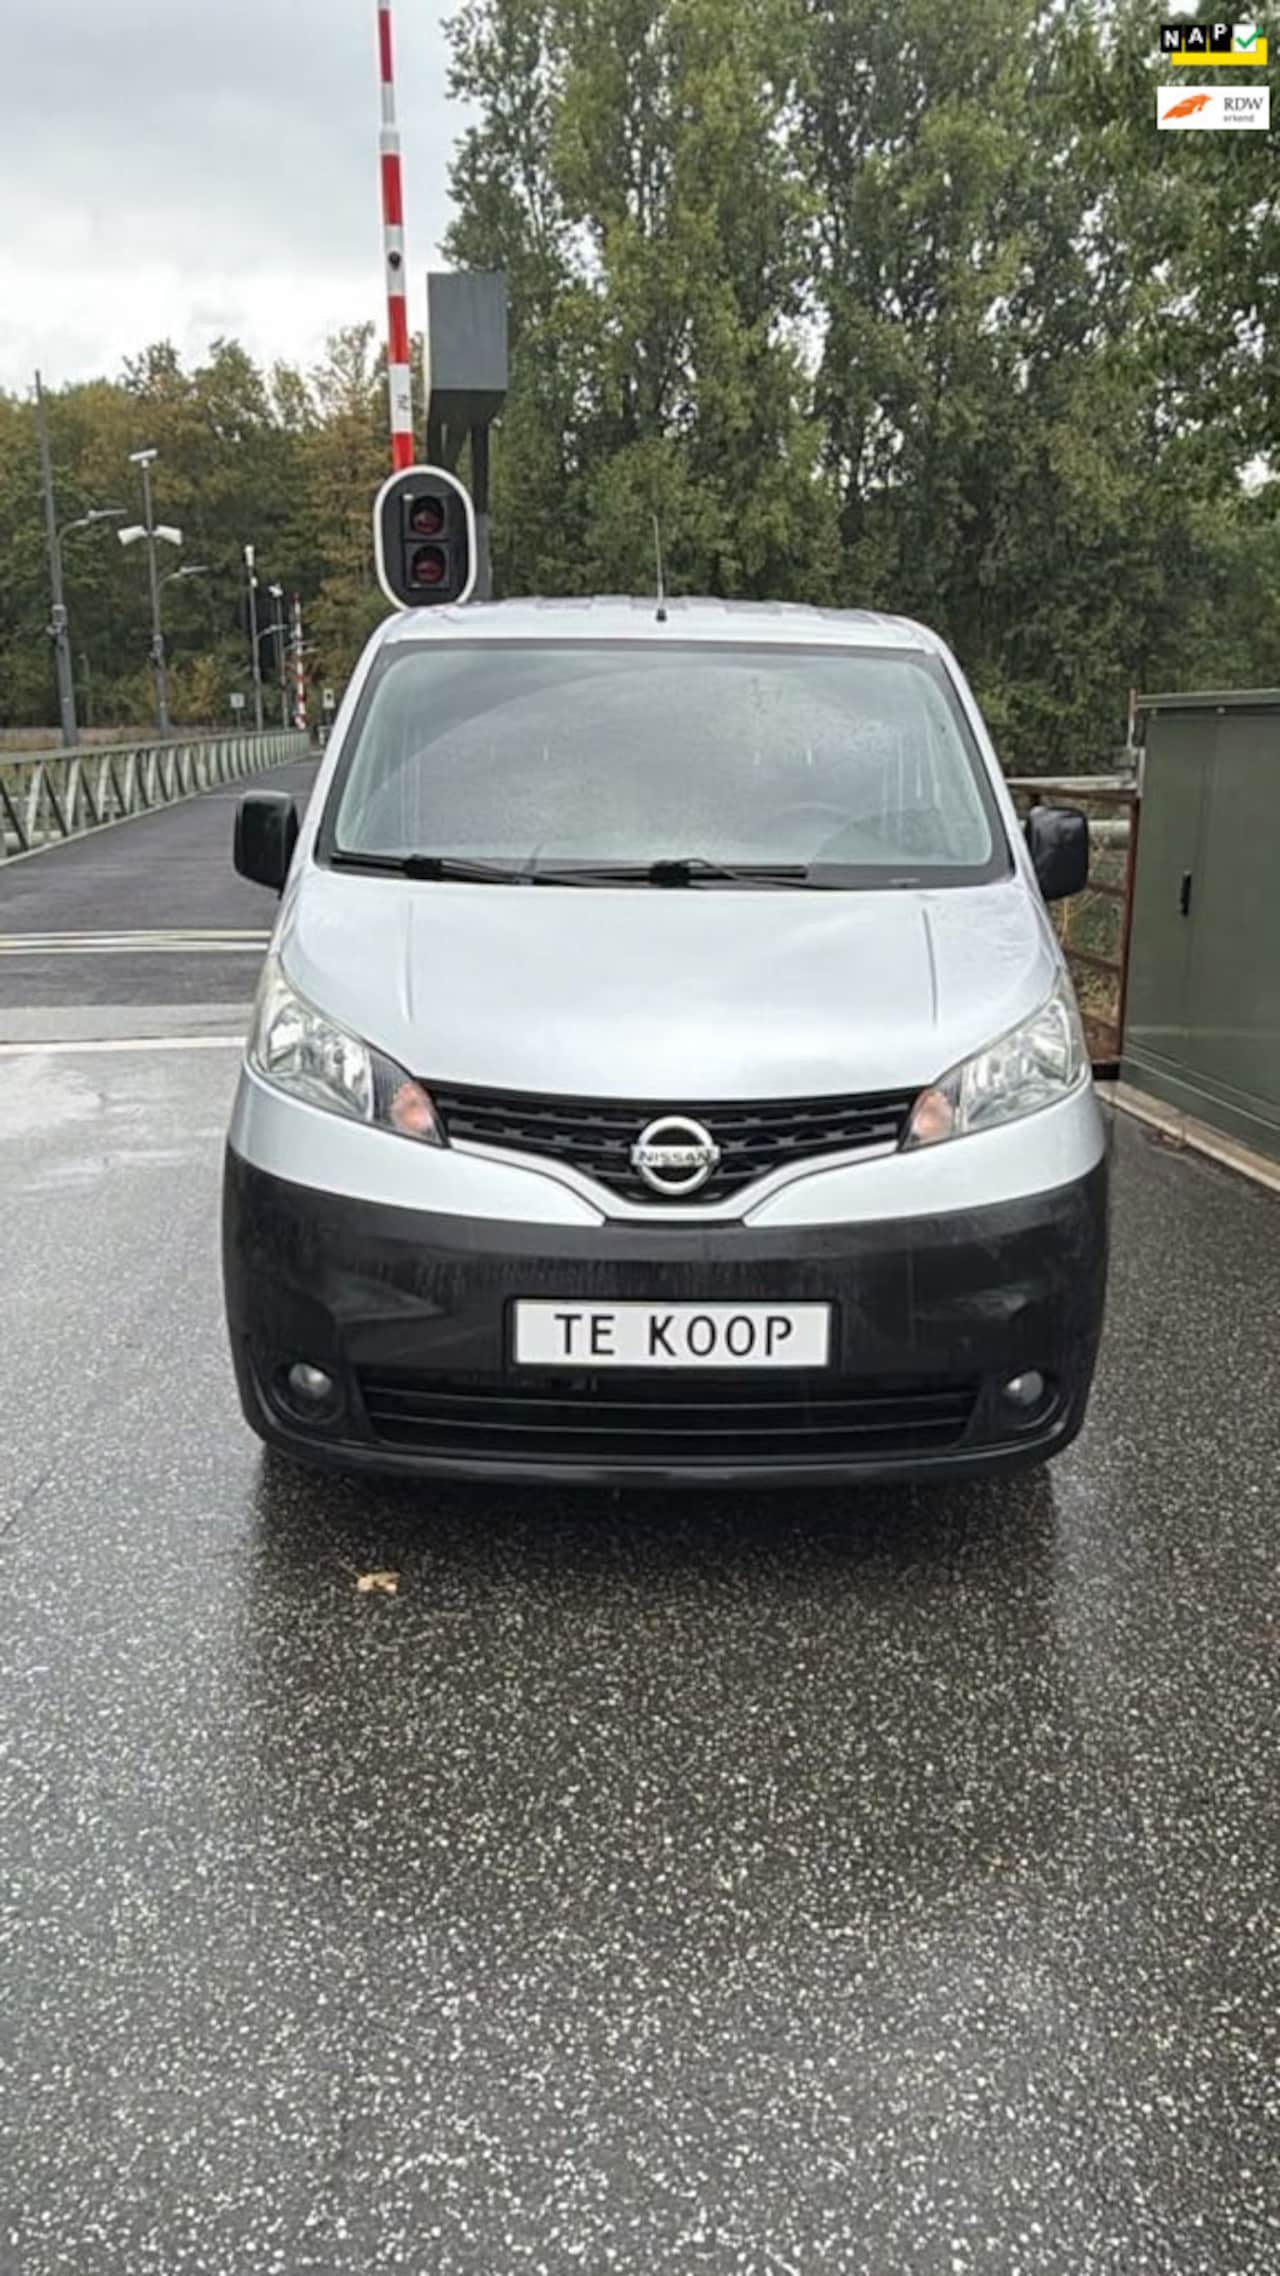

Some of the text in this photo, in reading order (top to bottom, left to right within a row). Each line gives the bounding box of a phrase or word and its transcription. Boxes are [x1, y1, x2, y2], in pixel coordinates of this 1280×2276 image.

[637, 1148, 714, 1164] NISSAN
[554, 1314, 793, 1357] TE KOOP
